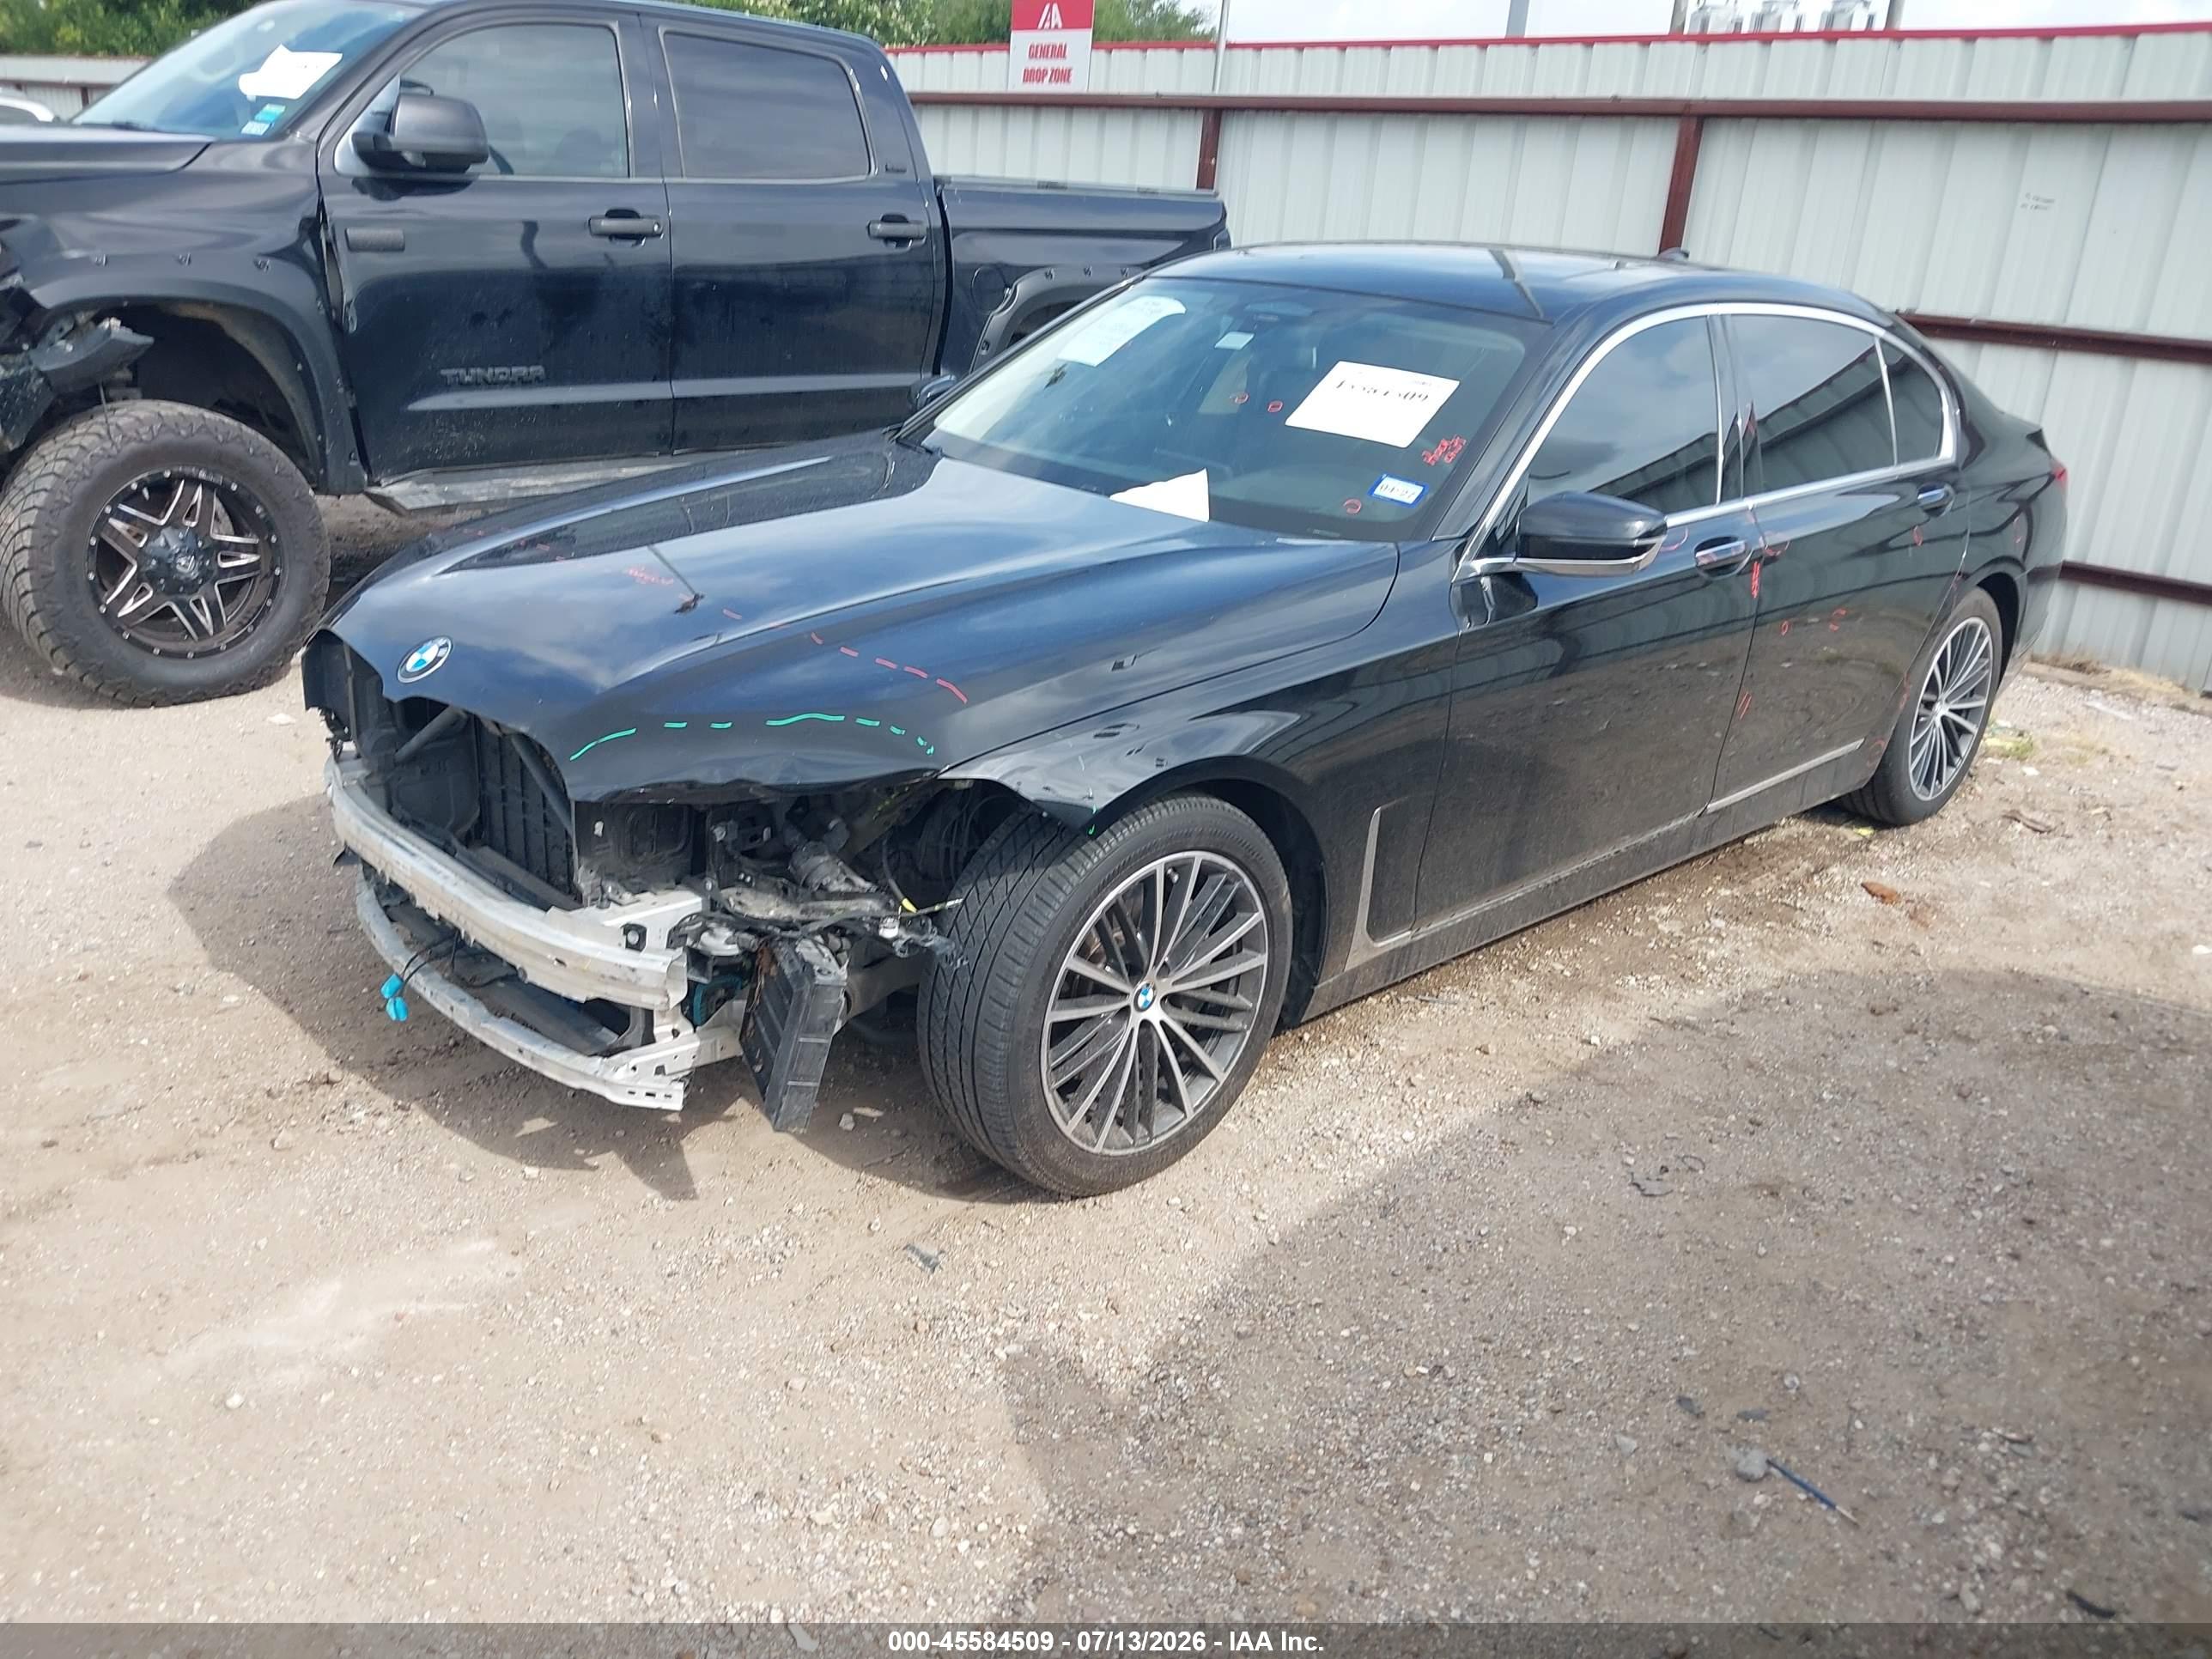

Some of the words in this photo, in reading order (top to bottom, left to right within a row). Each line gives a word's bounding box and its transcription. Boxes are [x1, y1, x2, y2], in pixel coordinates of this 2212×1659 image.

[1028, 42, 1067, 60] GENERAL
[1022, 67, 1048, 83] DROP
[1048, 66, 1073, 83] ZONE
[440, 365, 545, 386] TUNDRA
